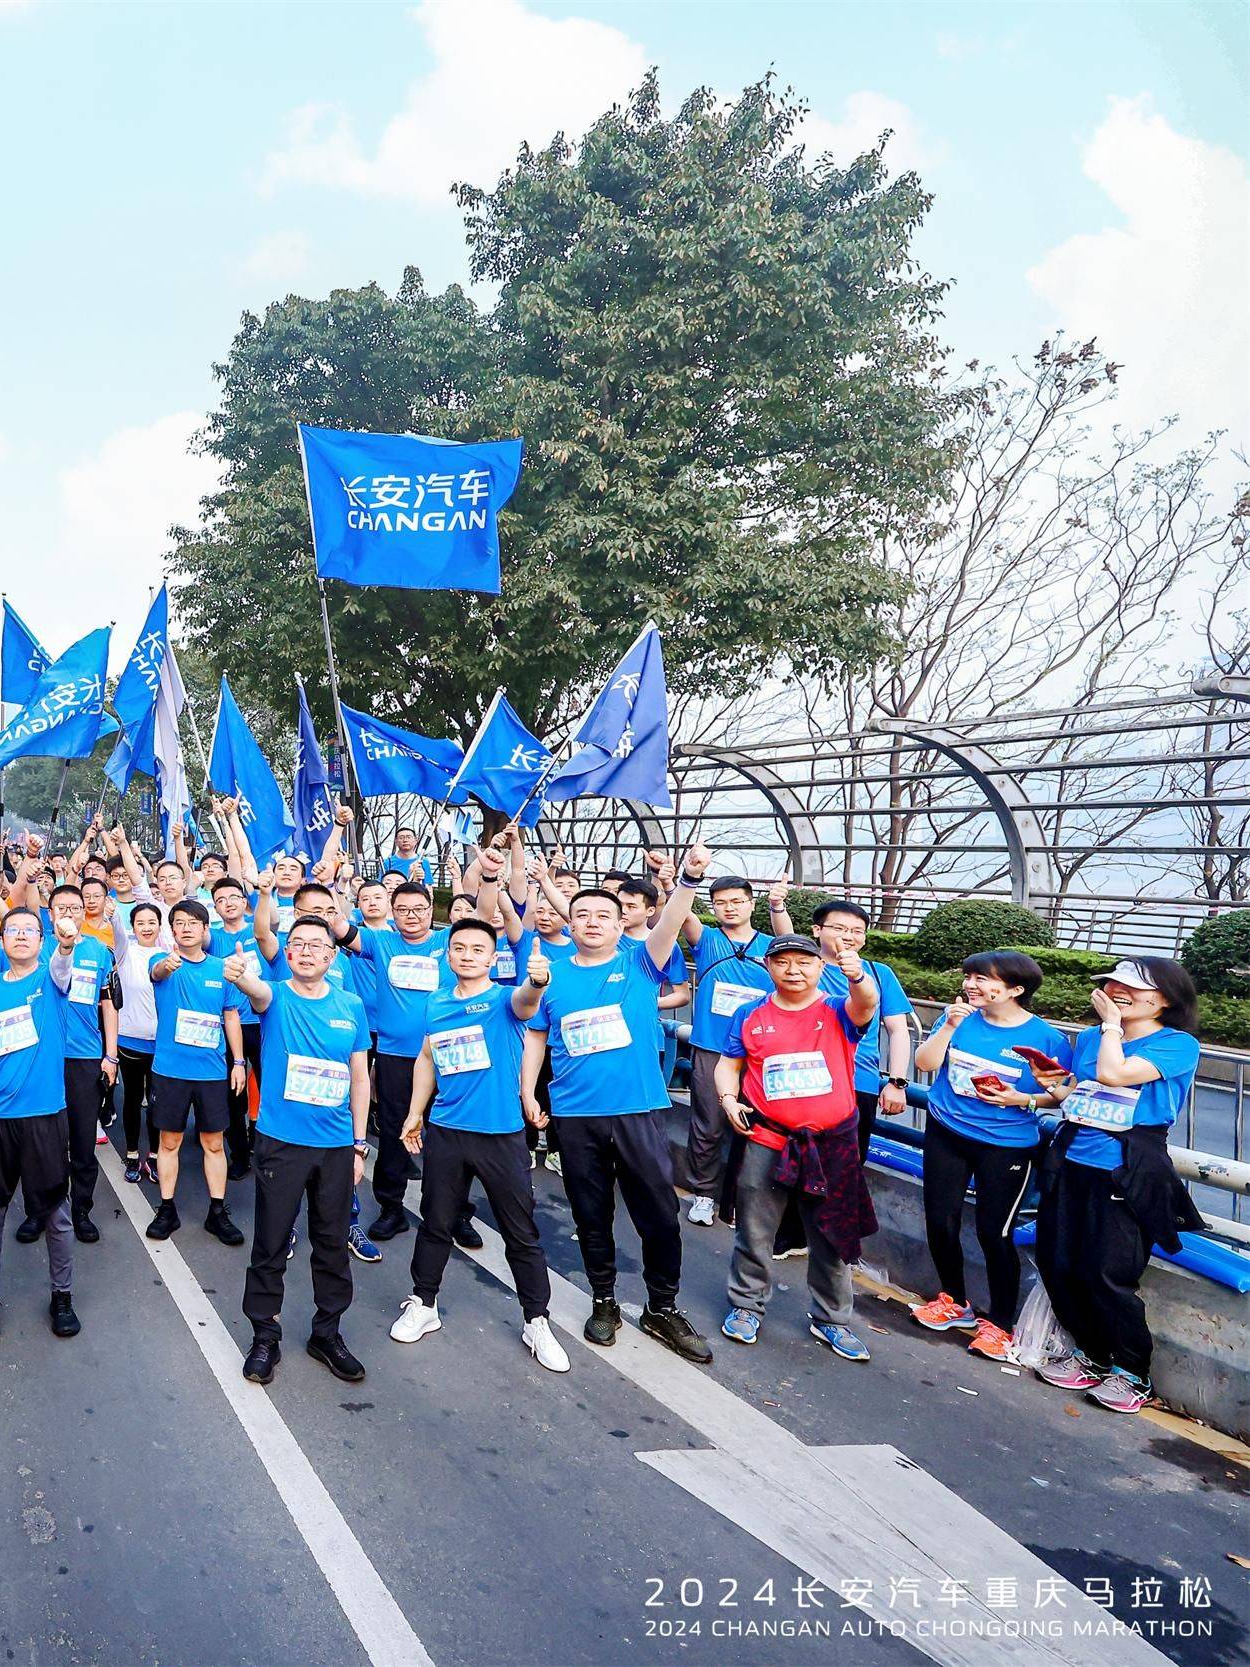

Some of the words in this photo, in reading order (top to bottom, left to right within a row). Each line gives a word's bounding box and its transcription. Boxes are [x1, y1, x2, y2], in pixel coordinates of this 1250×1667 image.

[340, 469, 490, 509] 长安汽车
[347, 509, 487, 532] CHANGAN
[291, 1075, 346, 1098] E72738
